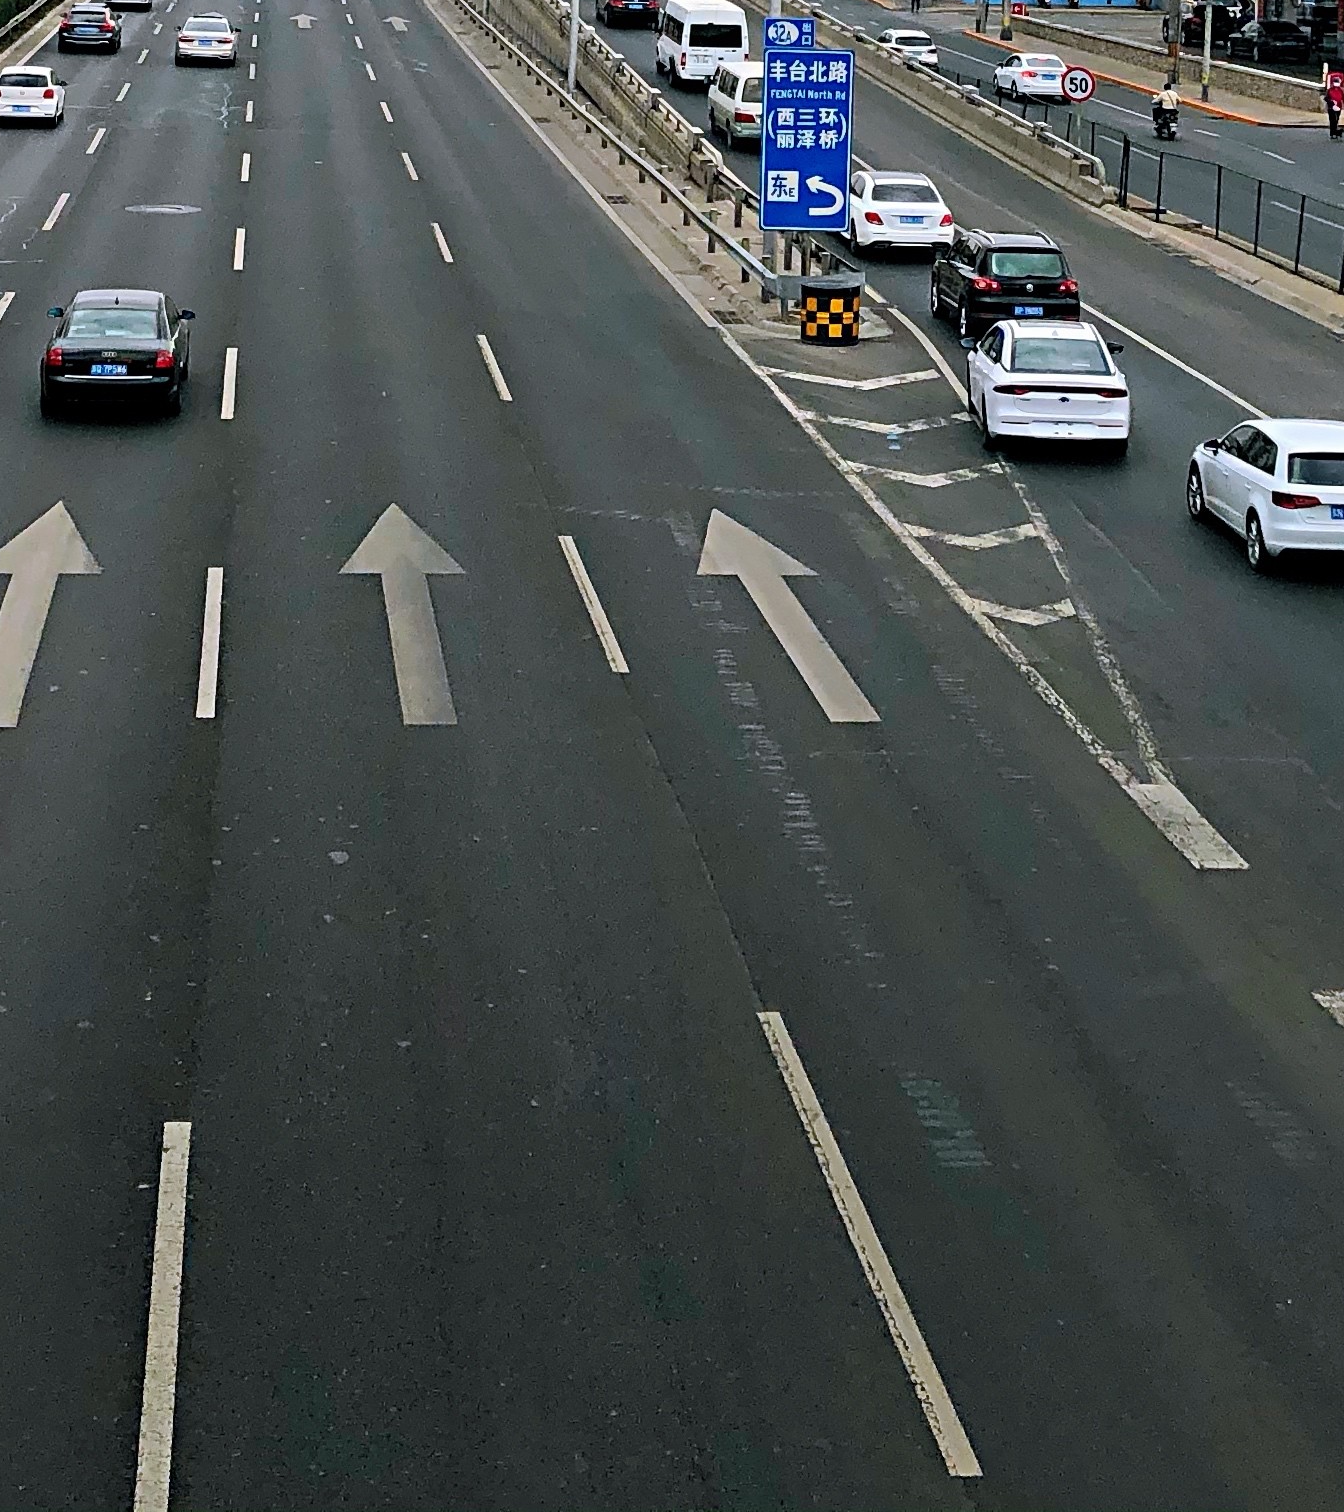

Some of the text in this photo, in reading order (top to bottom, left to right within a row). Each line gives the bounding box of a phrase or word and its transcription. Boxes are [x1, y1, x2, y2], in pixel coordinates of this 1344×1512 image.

[771, 22, 812, 46] 32A 出口
[769, 59, 849, 84] 丰台北路
[770, 89, 847, 101] FENGTAI North Rd
[1068, 76, 1089, 94] 50
